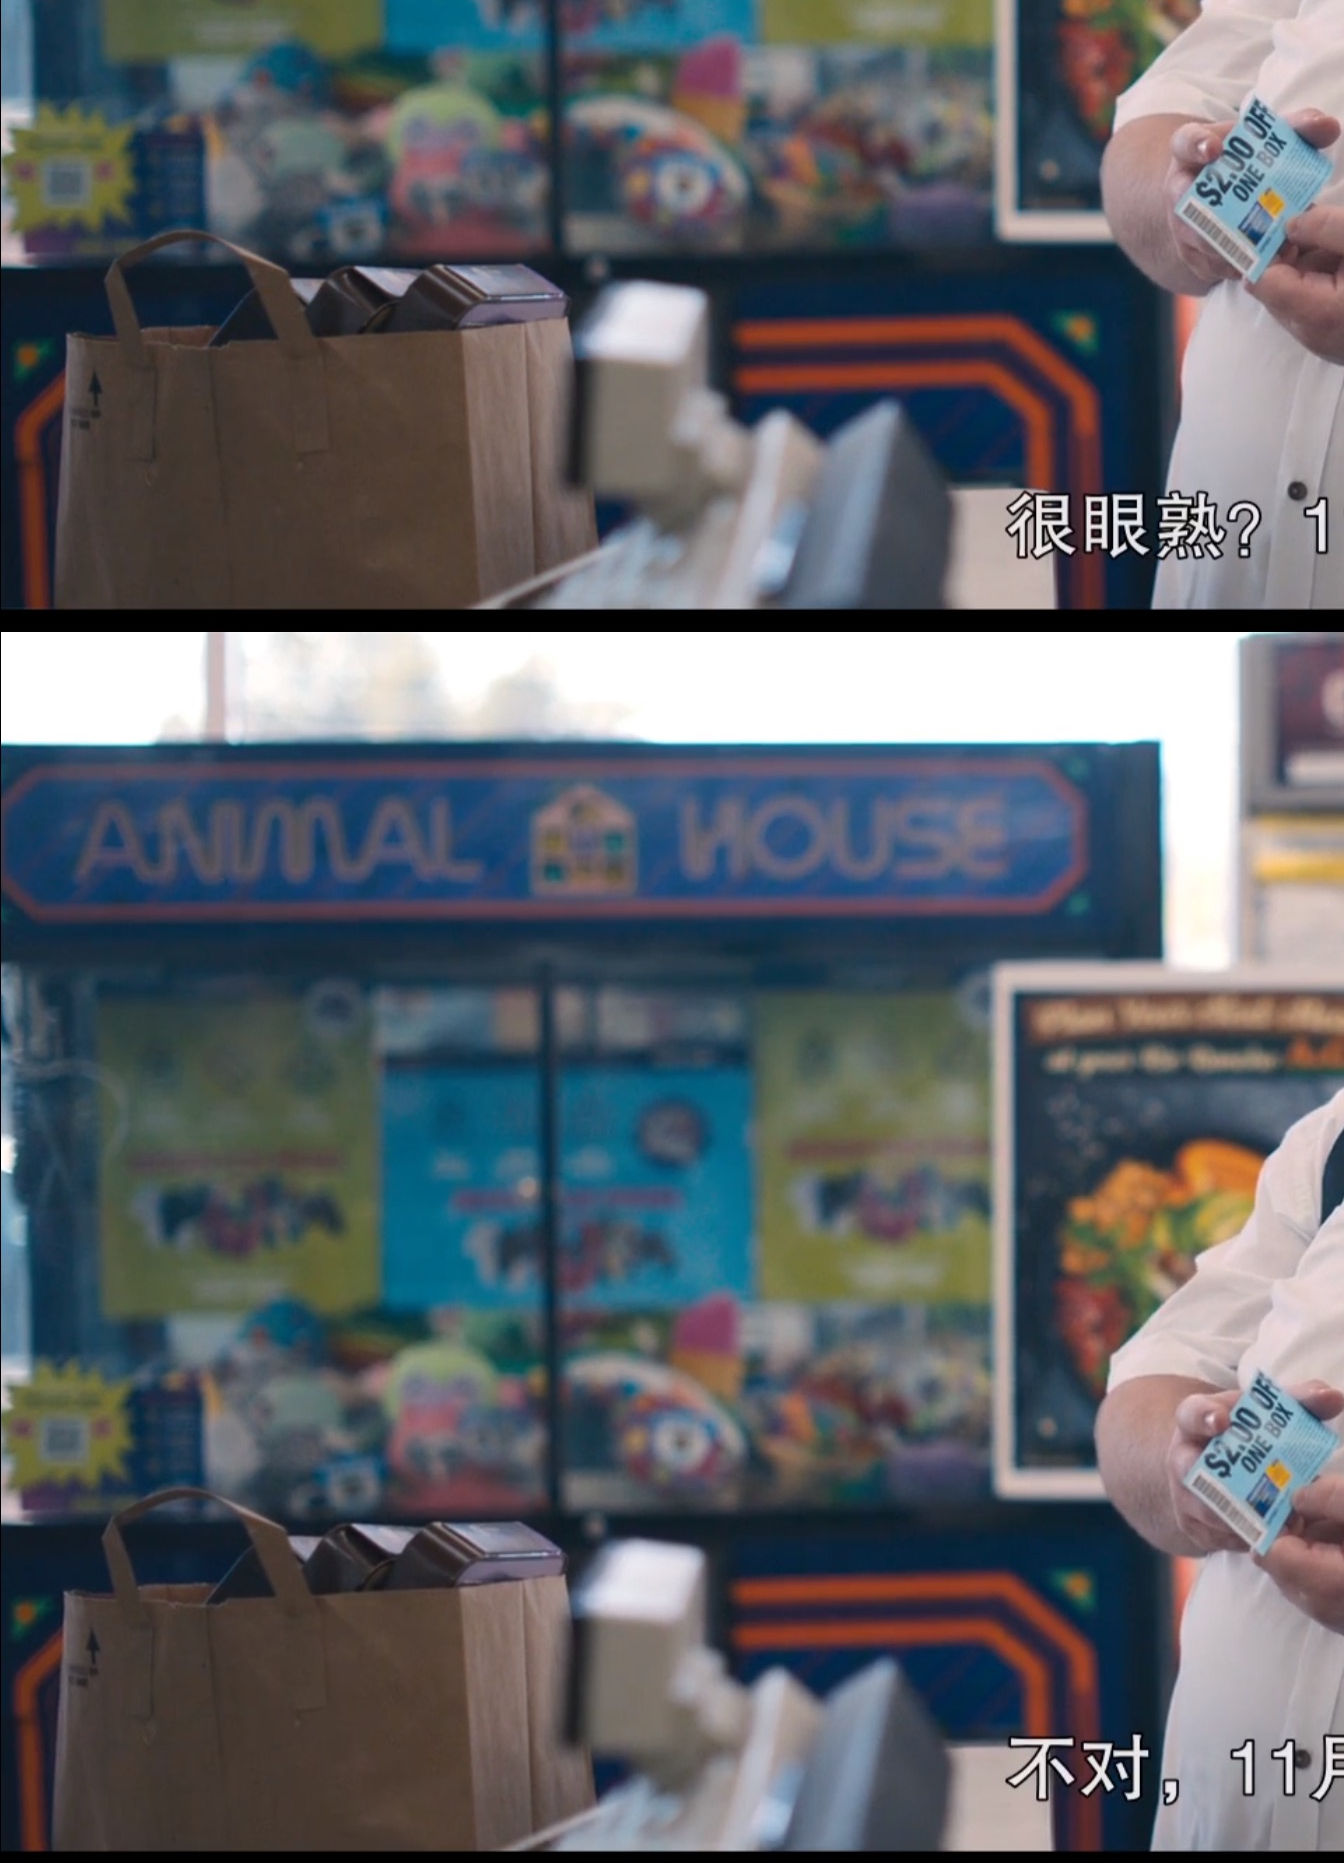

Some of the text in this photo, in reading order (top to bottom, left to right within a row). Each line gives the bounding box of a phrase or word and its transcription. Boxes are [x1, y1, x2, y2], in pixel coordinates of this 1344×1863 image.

[1195, 135, 1255, 208] $2.00
[1232, 130, 1288, 203] ONE BOX
[73, 795, 1011, 885] ANIMAL HOUSE
[1240, 1400, 1295, 1475] ONE BOX
